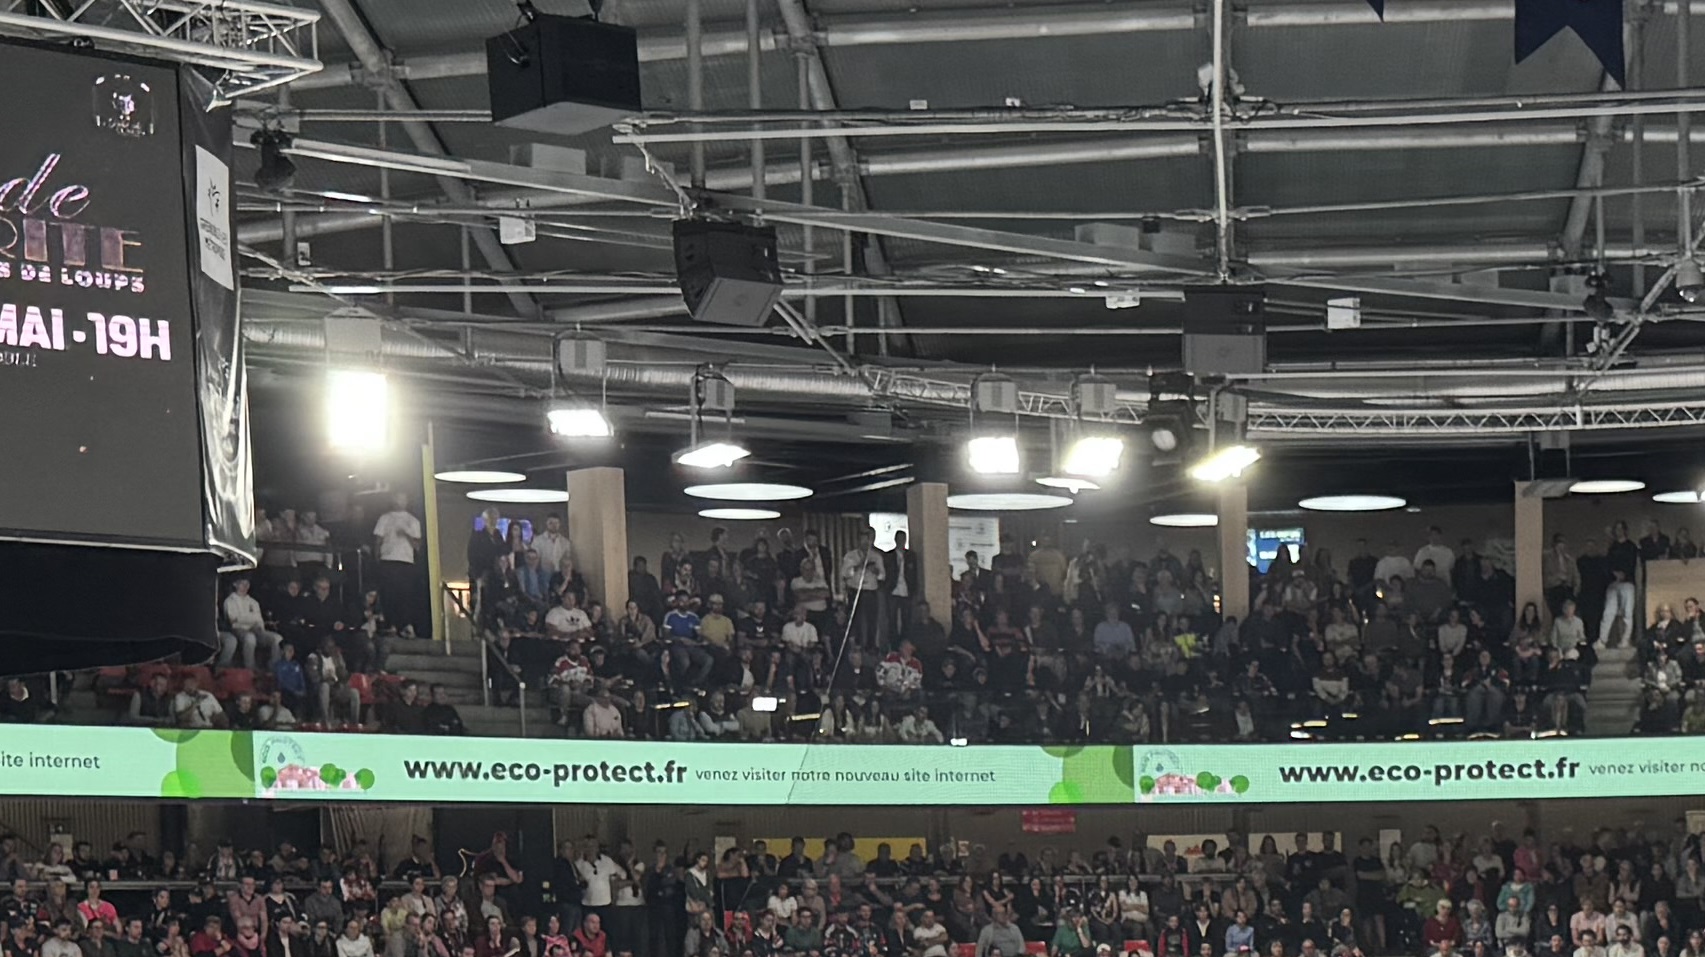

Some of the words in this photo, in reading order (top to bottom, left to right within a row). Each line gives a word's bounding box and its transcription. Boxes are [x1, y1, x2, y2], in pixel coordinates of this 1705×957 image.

[21, 263, 51, 283] DE
[61, 267, 145, 293] LOUPS
[30, 752, 100, 769] internet
[404, 760, 687, 787] www.eco-protect.fr
[696, 769, 738, 781] venez
[742, 767, 786, 782] visiter
[792, 768, 830, 782] notre
[836, 769, 899, 783] nouveau
[904, 767, 930, 782] site
[935, 767, 996, 783] internet
[1279, 757, 1580, 786] www.eco-protect.fr
[1589, 763, 1634, 776] venez
[1639, 759, 1684, 774] visiter
